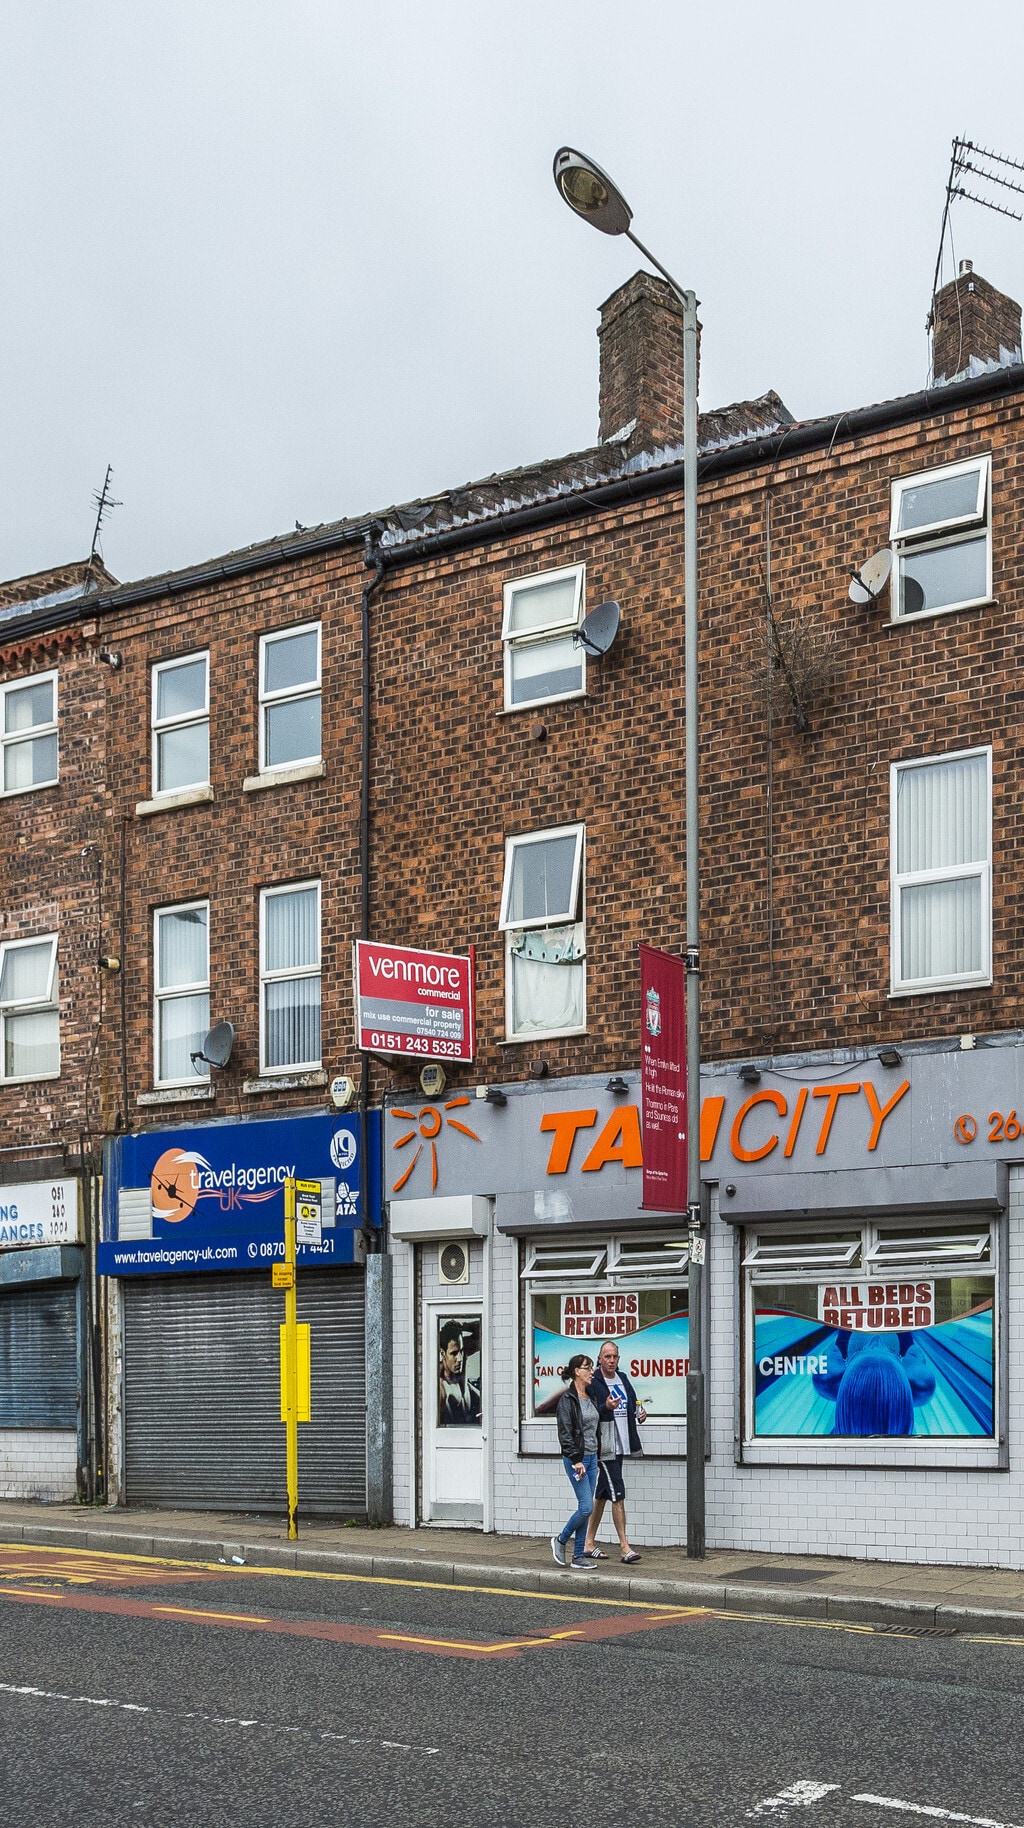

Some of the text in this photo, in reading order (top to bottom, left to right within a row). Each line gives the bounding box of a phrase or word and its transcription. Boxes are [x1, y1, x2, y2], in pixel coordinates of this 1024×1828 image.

[368, 956, 460, 988] venmore
[417, 987, 460, 1000] commercial
[363, 1011, 461, 1031] mix use commercial property
[425, 1006, 461, 1020] for sale
[416, 1028, 435, 1036] 07540
[437, 1030, 449, 1038] 724
[371, 1033, 462, 1056] 0151 243 5325
[51, 1186, 64, 1200] 051
[219, 1188, 243, 1211] UK
[114, 1246, 238, 1266] www.travelagency-uk.com
[260, 1242, 285, 1257] 0870
[564, 1294, 637, 1315] ALL BEDS
[822, 1283, 932, 1307] ALL BEDS
[564, 1315, 637, 1336] RETUBED
[823, 1307, 931, 1329] RETUBED
[536, 1366, 554, 1377] TAN
[630, 1359, 690, 1378] SUNBE
[759, 1355, 828, 1376] CENTRE
